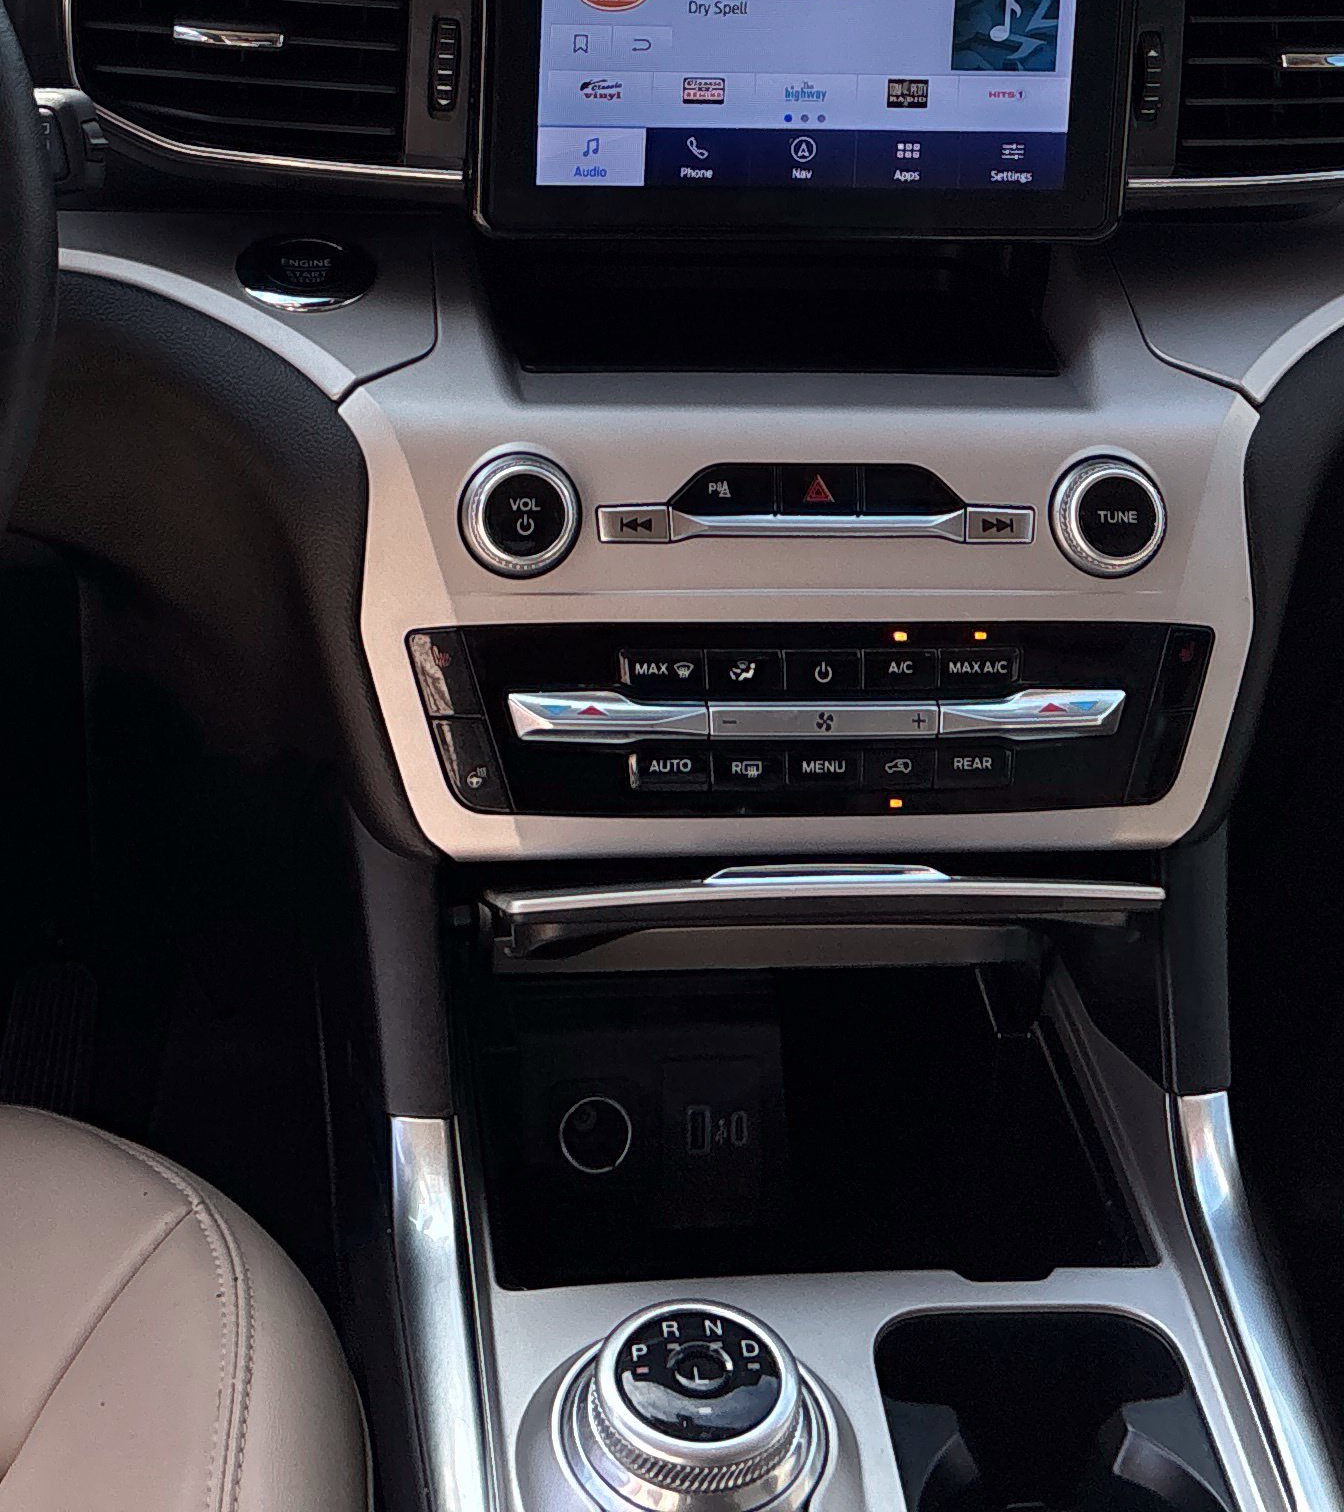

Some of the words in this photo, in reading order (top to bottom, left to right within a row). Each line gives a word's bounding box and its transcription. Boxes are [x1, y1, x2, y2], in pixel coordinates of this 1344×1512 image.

[688, 1, 710, 16] Dry
[714, 1, 748, 17] Spell
[573, 166, 607, 178] Audio
[680, 167, 713, 179] Phone
[792, 168, 812, 179] Nav
[894, 169, 920, 182] Apps
[991, 170, 1032, 183] Settings
[281, 257, 332, 267] ENGINE
[509, 497, 541, 511] VOL
[1097, 510, 1138, 524] TUNE
[635, 662, 668, 676] MAX
[888, 662, 913, 674] A/C
[948, 661, 981, 674] MAX
[983, 662, 1008, 675] A/C
[649, 759, 692, 773] AUTO
[801, 760, 846, 774] MENU
[953, 757, 993, 771] REAR
[632, 1344, 648, 1361] P
[662, 1321, 680, 1337] R
[703, 1319, 723, 1336] N
[740, 1340, 759, 1357] D
[693, 1366, 710, 1385] L
